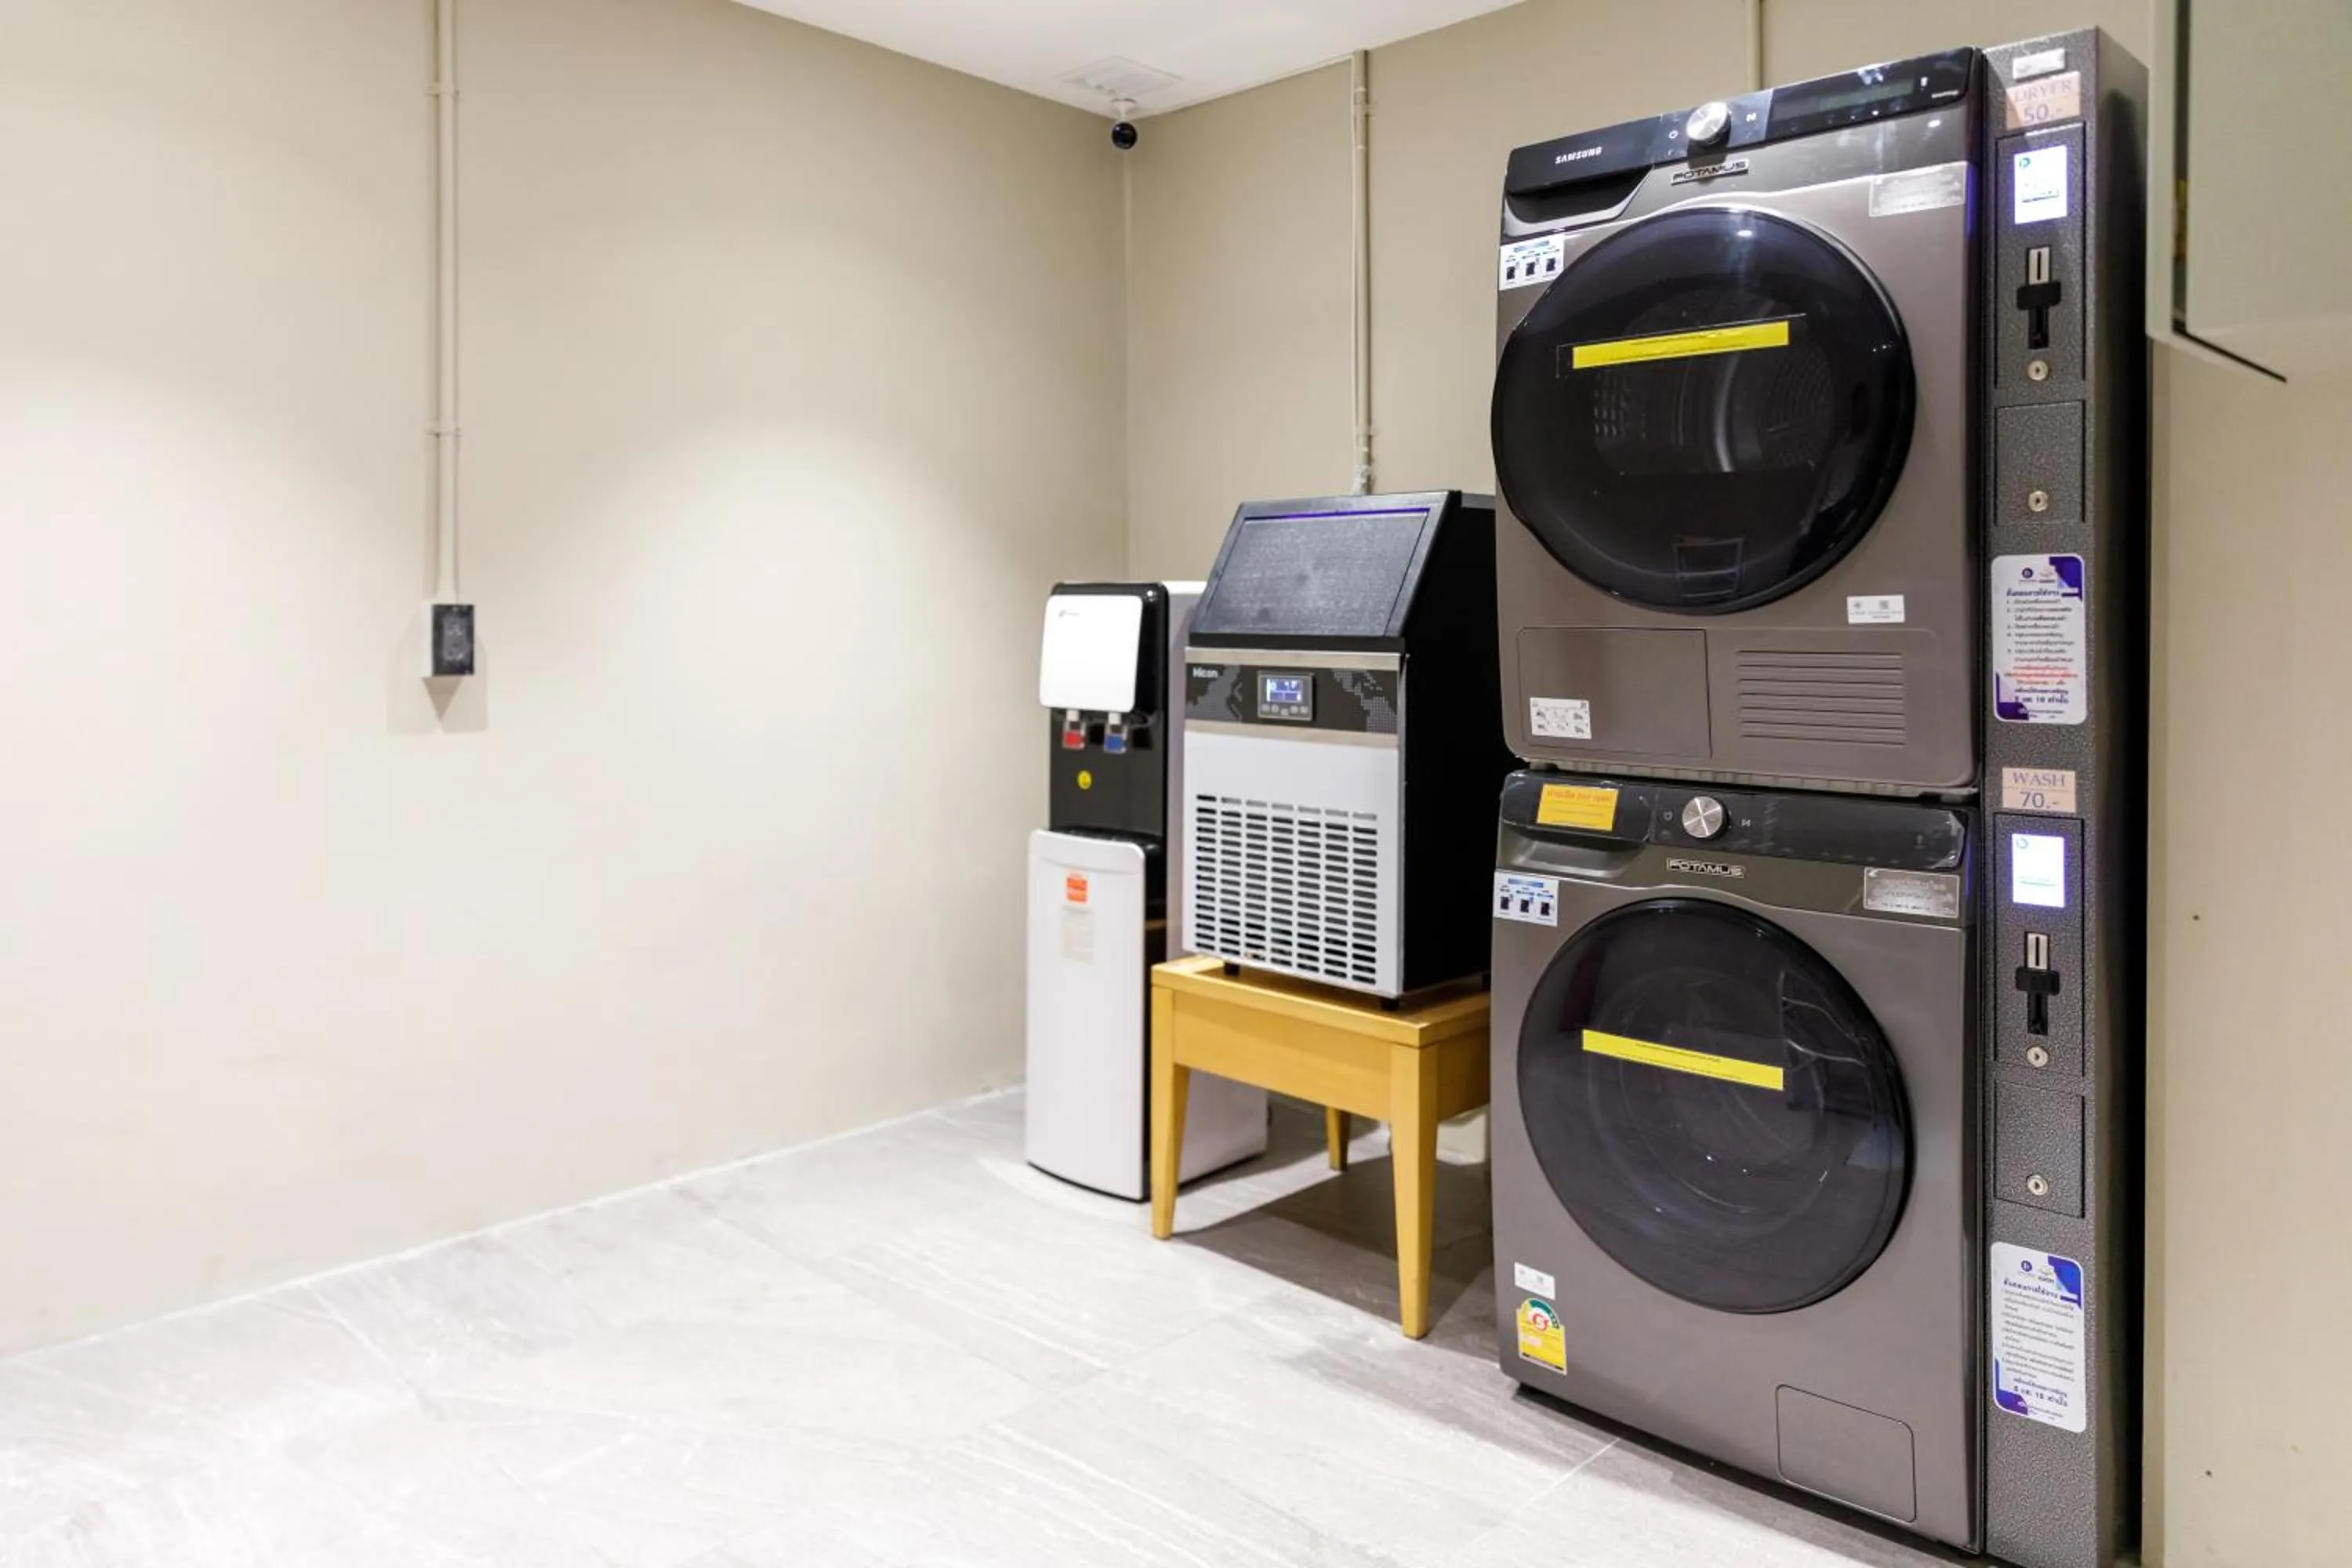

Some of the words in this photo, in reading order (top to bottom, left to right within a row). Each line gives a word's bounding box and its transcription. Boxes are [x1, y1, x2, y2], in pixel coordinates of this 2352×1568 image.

[1555, 146, 1602, 164] SAMSUNG
[2013, 771, 2066, 787] WASH
[2020, 790, 2058, 809] 70.-
[1668, 859, 1744, 878] POTAMUS
